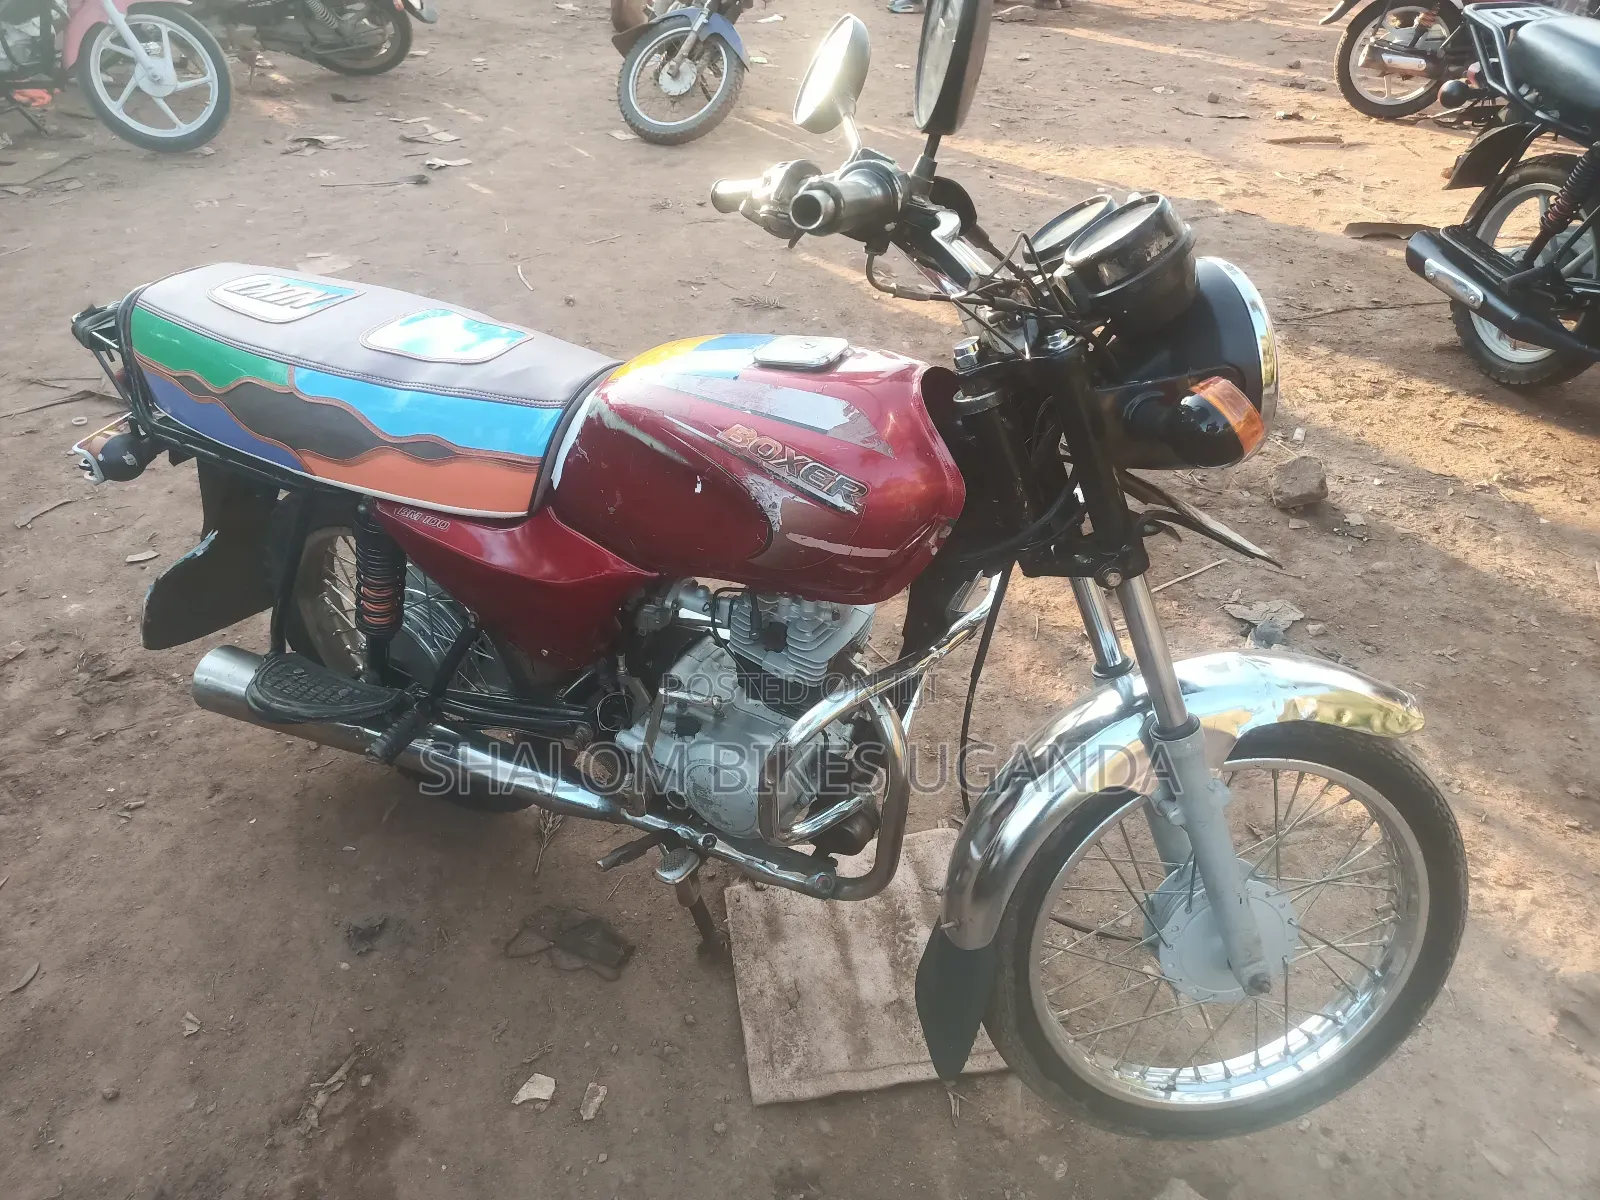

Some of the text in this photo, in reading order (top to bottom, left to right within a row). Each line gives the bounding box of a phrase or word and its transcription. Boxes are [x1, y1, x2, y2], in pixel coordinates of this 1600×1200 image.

[718, 423, 869, 507] BOXER
[396, 506, 451, 531] BM 100
